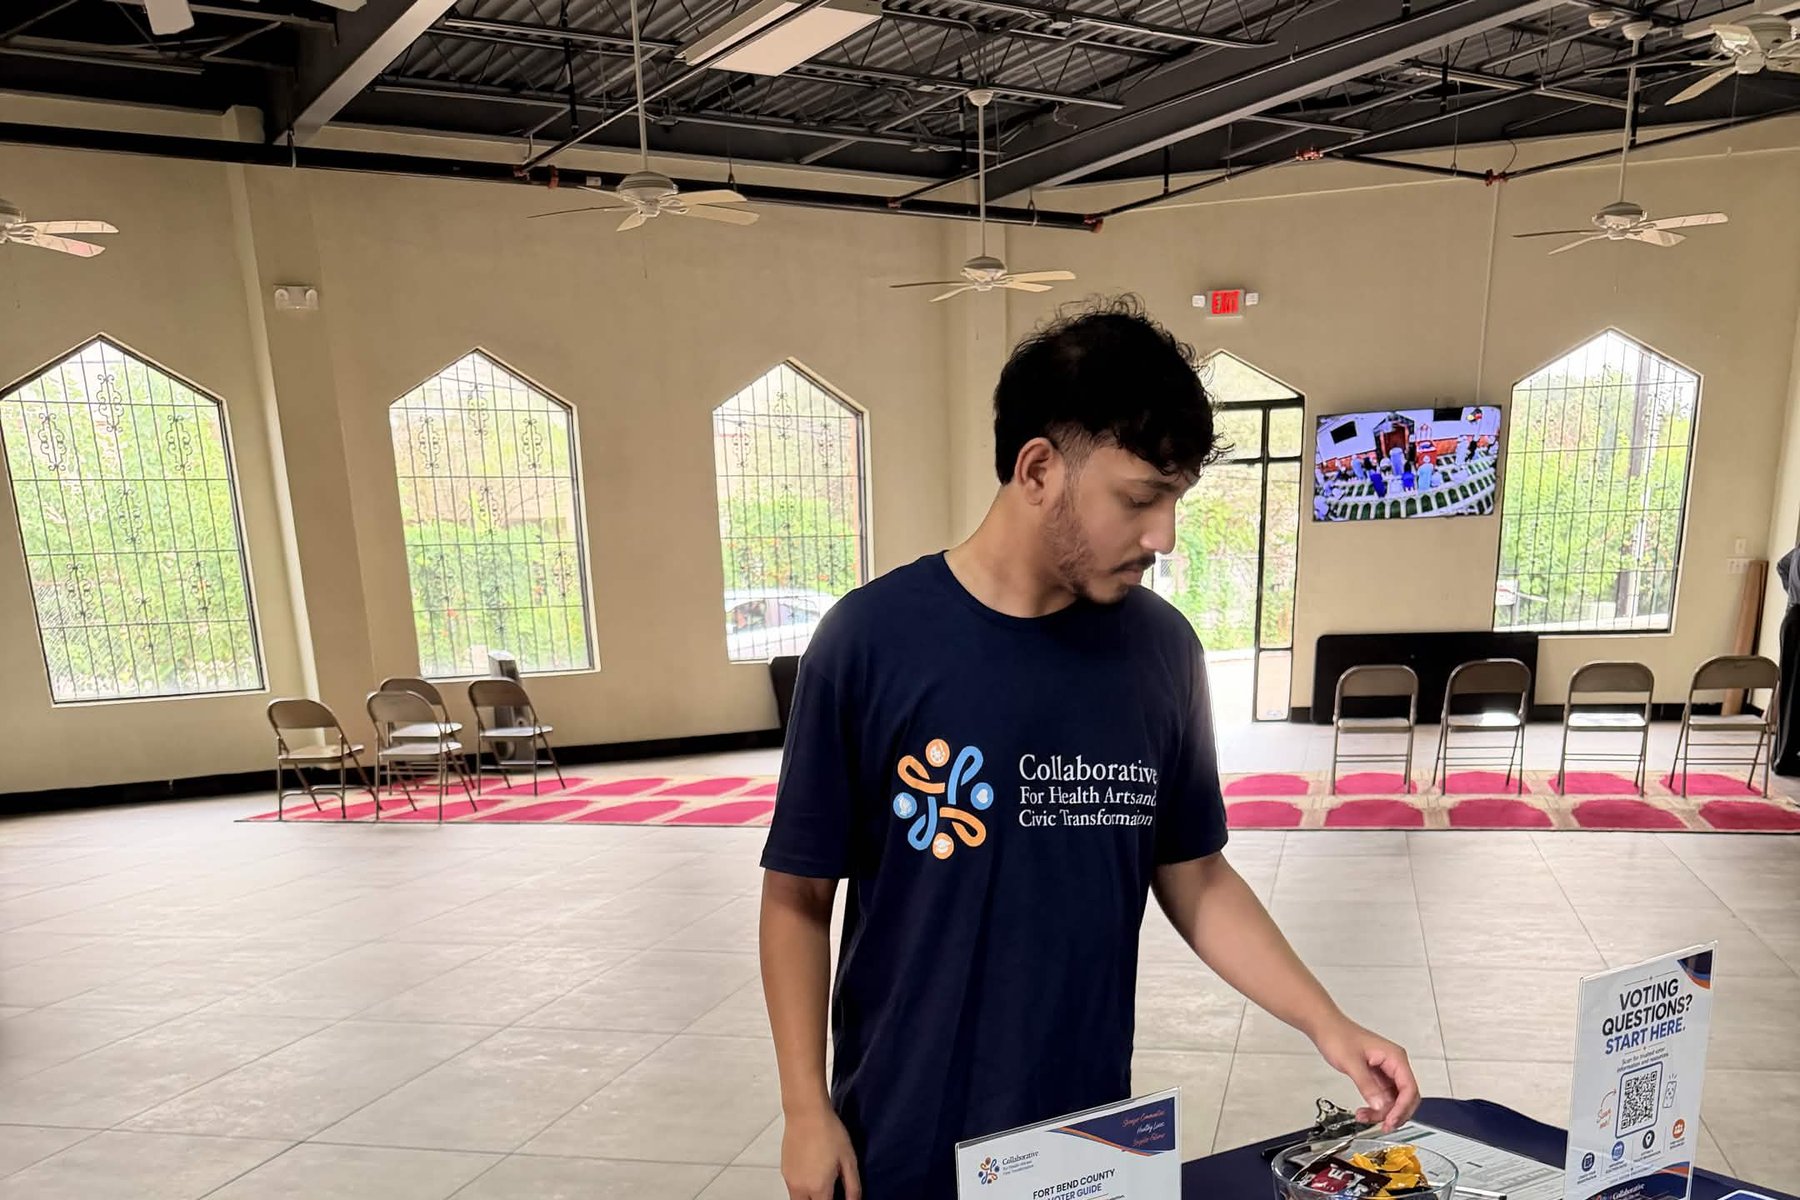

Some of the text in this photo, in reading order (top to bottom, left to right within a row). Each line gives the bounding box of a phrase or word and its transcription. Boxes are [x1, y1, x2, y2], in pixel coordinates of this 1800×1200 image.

[1018, 753, 1158, 785] Collaborative
[1020, 786, 1045, 804] For
[1049, 786, 1100, 805] Health
[1019, 807, 1153, 826] Civic Transformaion
[1620, 979, 1678, 1009] VOTING
[1602, 994, 1692, 1035] QUESTIONS?
[1605, 1017, 1685, 1054] START HERE.
[1033, 1168, 1114, 1199] FORT BEND COUNTY
[1076, 1182, 1101, 1197] GUIDE
